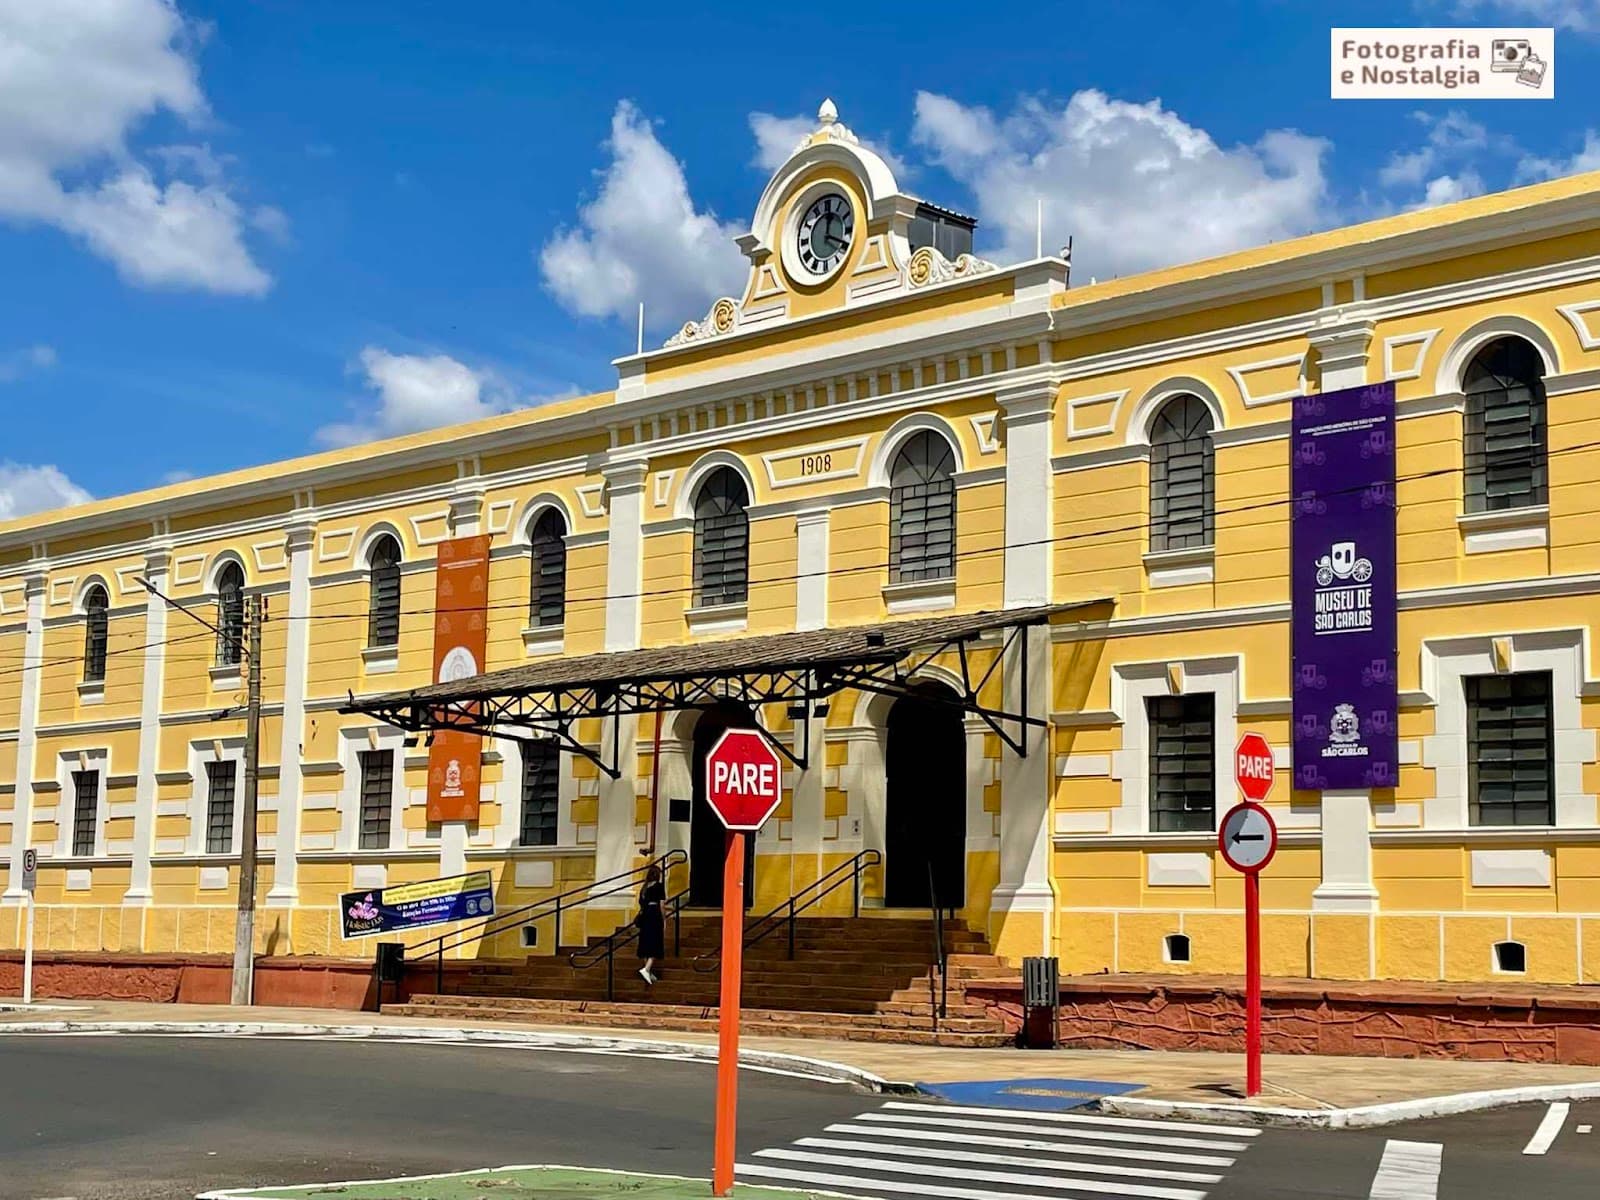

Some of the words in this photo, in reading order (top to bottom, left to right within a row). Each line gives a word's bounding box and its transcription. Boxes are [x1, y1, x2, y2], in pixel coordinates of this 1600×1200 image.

[801, 454, 831, 476] 1908
[1315, 590, 1354, 613] MUSEU
[1357, 588, 1372, 609] DE
[1315, 611, 1334, 630] SÃO
[1335, 609, 1372, 628] CARLOS
[1337, 747, 1369, 756] CARLOS
[1239, 754, 1272, 780] PARE
[714, 761, 775, 797] PARE
[27, 854, 33, 868] E
